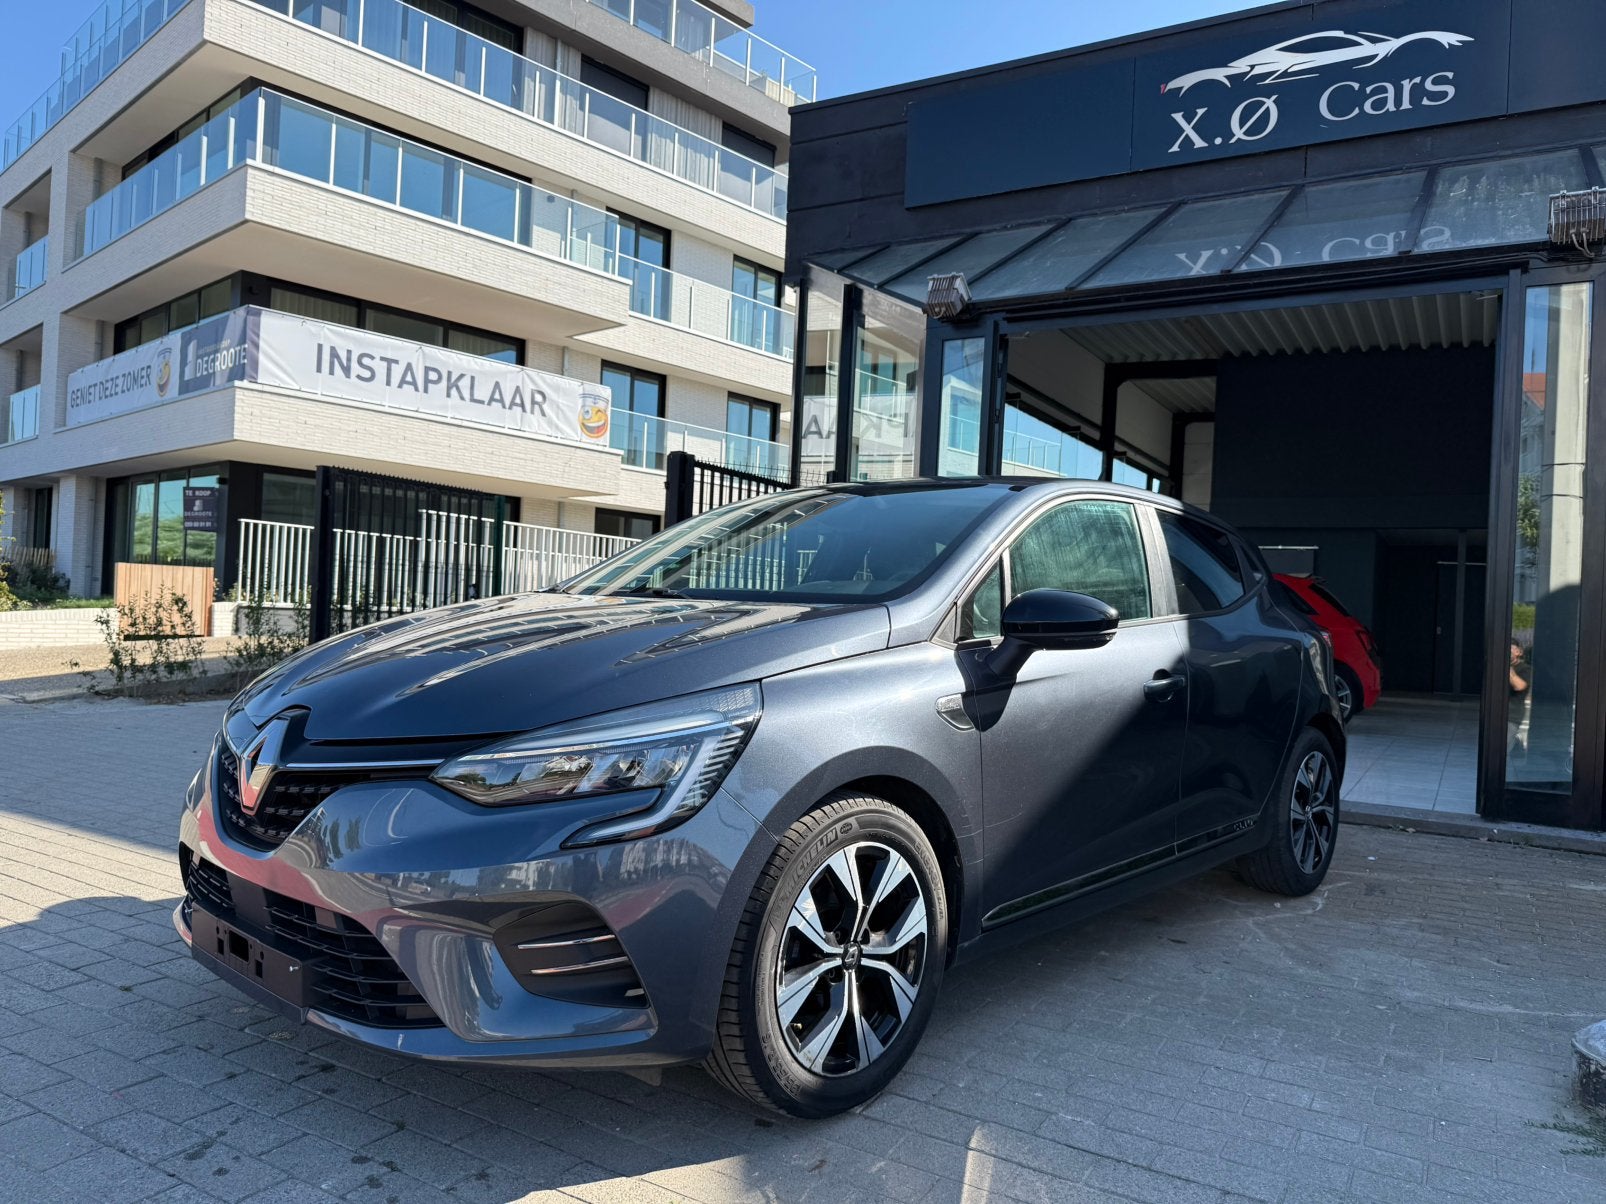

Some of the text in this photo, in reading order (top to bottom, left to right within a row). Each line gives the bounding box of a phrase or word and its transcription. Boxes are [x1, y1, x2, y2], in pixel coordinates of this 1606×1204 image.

[1168, 71, 1457, 153] X.Ø Cars
[70, 364, 152, 409] GENIET DEZE ZOMER
[196, 343, 248, 377] DEGROOTE
[316, 342, 547, 418] INSTAPKLAAR
